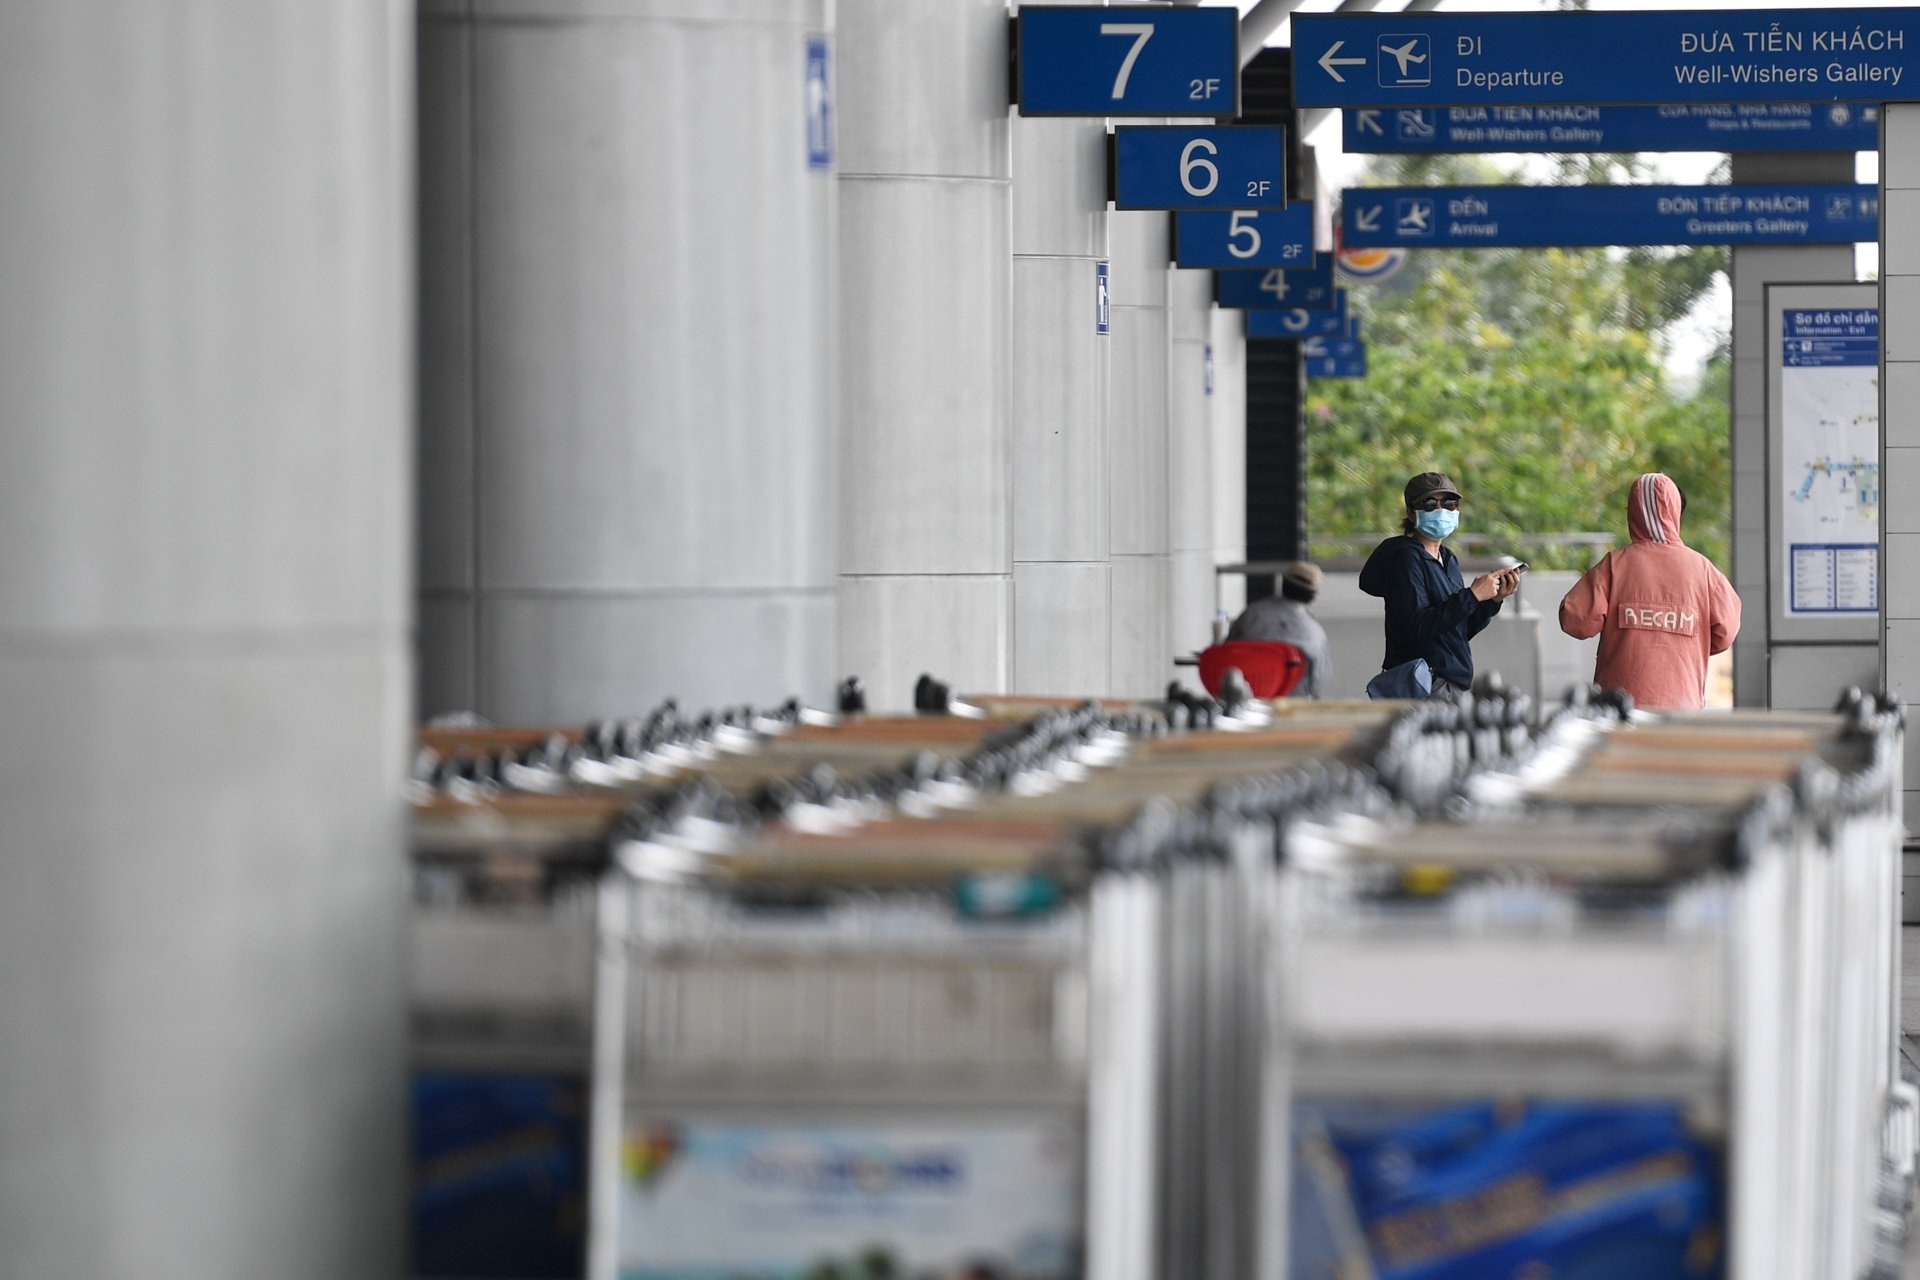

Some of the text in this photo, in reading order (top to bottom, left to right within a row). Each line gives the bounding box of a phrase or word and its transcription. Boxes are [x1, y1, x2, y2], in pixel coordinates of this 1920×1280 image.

[1457, 36, 1481, 55] ĐI
[1681, 22, 1904, 53] ĐƯA TIỄN KHÁCH
[1101, 23, 1155, 99] 7
[1457, 68, 1564, 91] Departure
[1674, 62, 1903, 85] Well-Wishers Gallery
[1189, 79, 1220, 99] 2F
[1450, 126, 1604, 145] Well-Wishers Gallery
[1180, 138, 1219, 197] 6
[1247, 181, 1271, 197] 2F
[1227, 210, 1261, 258] 5
[1449, 221, 1498, 236] Arrival
[1686, 217, 1809, 237] Greeters Gallery
[1282, 244, 1303, 259] 2F
[1260, 268, 1291, 301] 4
[1796, 326, 1842, 336] Information
[1624, 607, 1695, 635] RECAM
